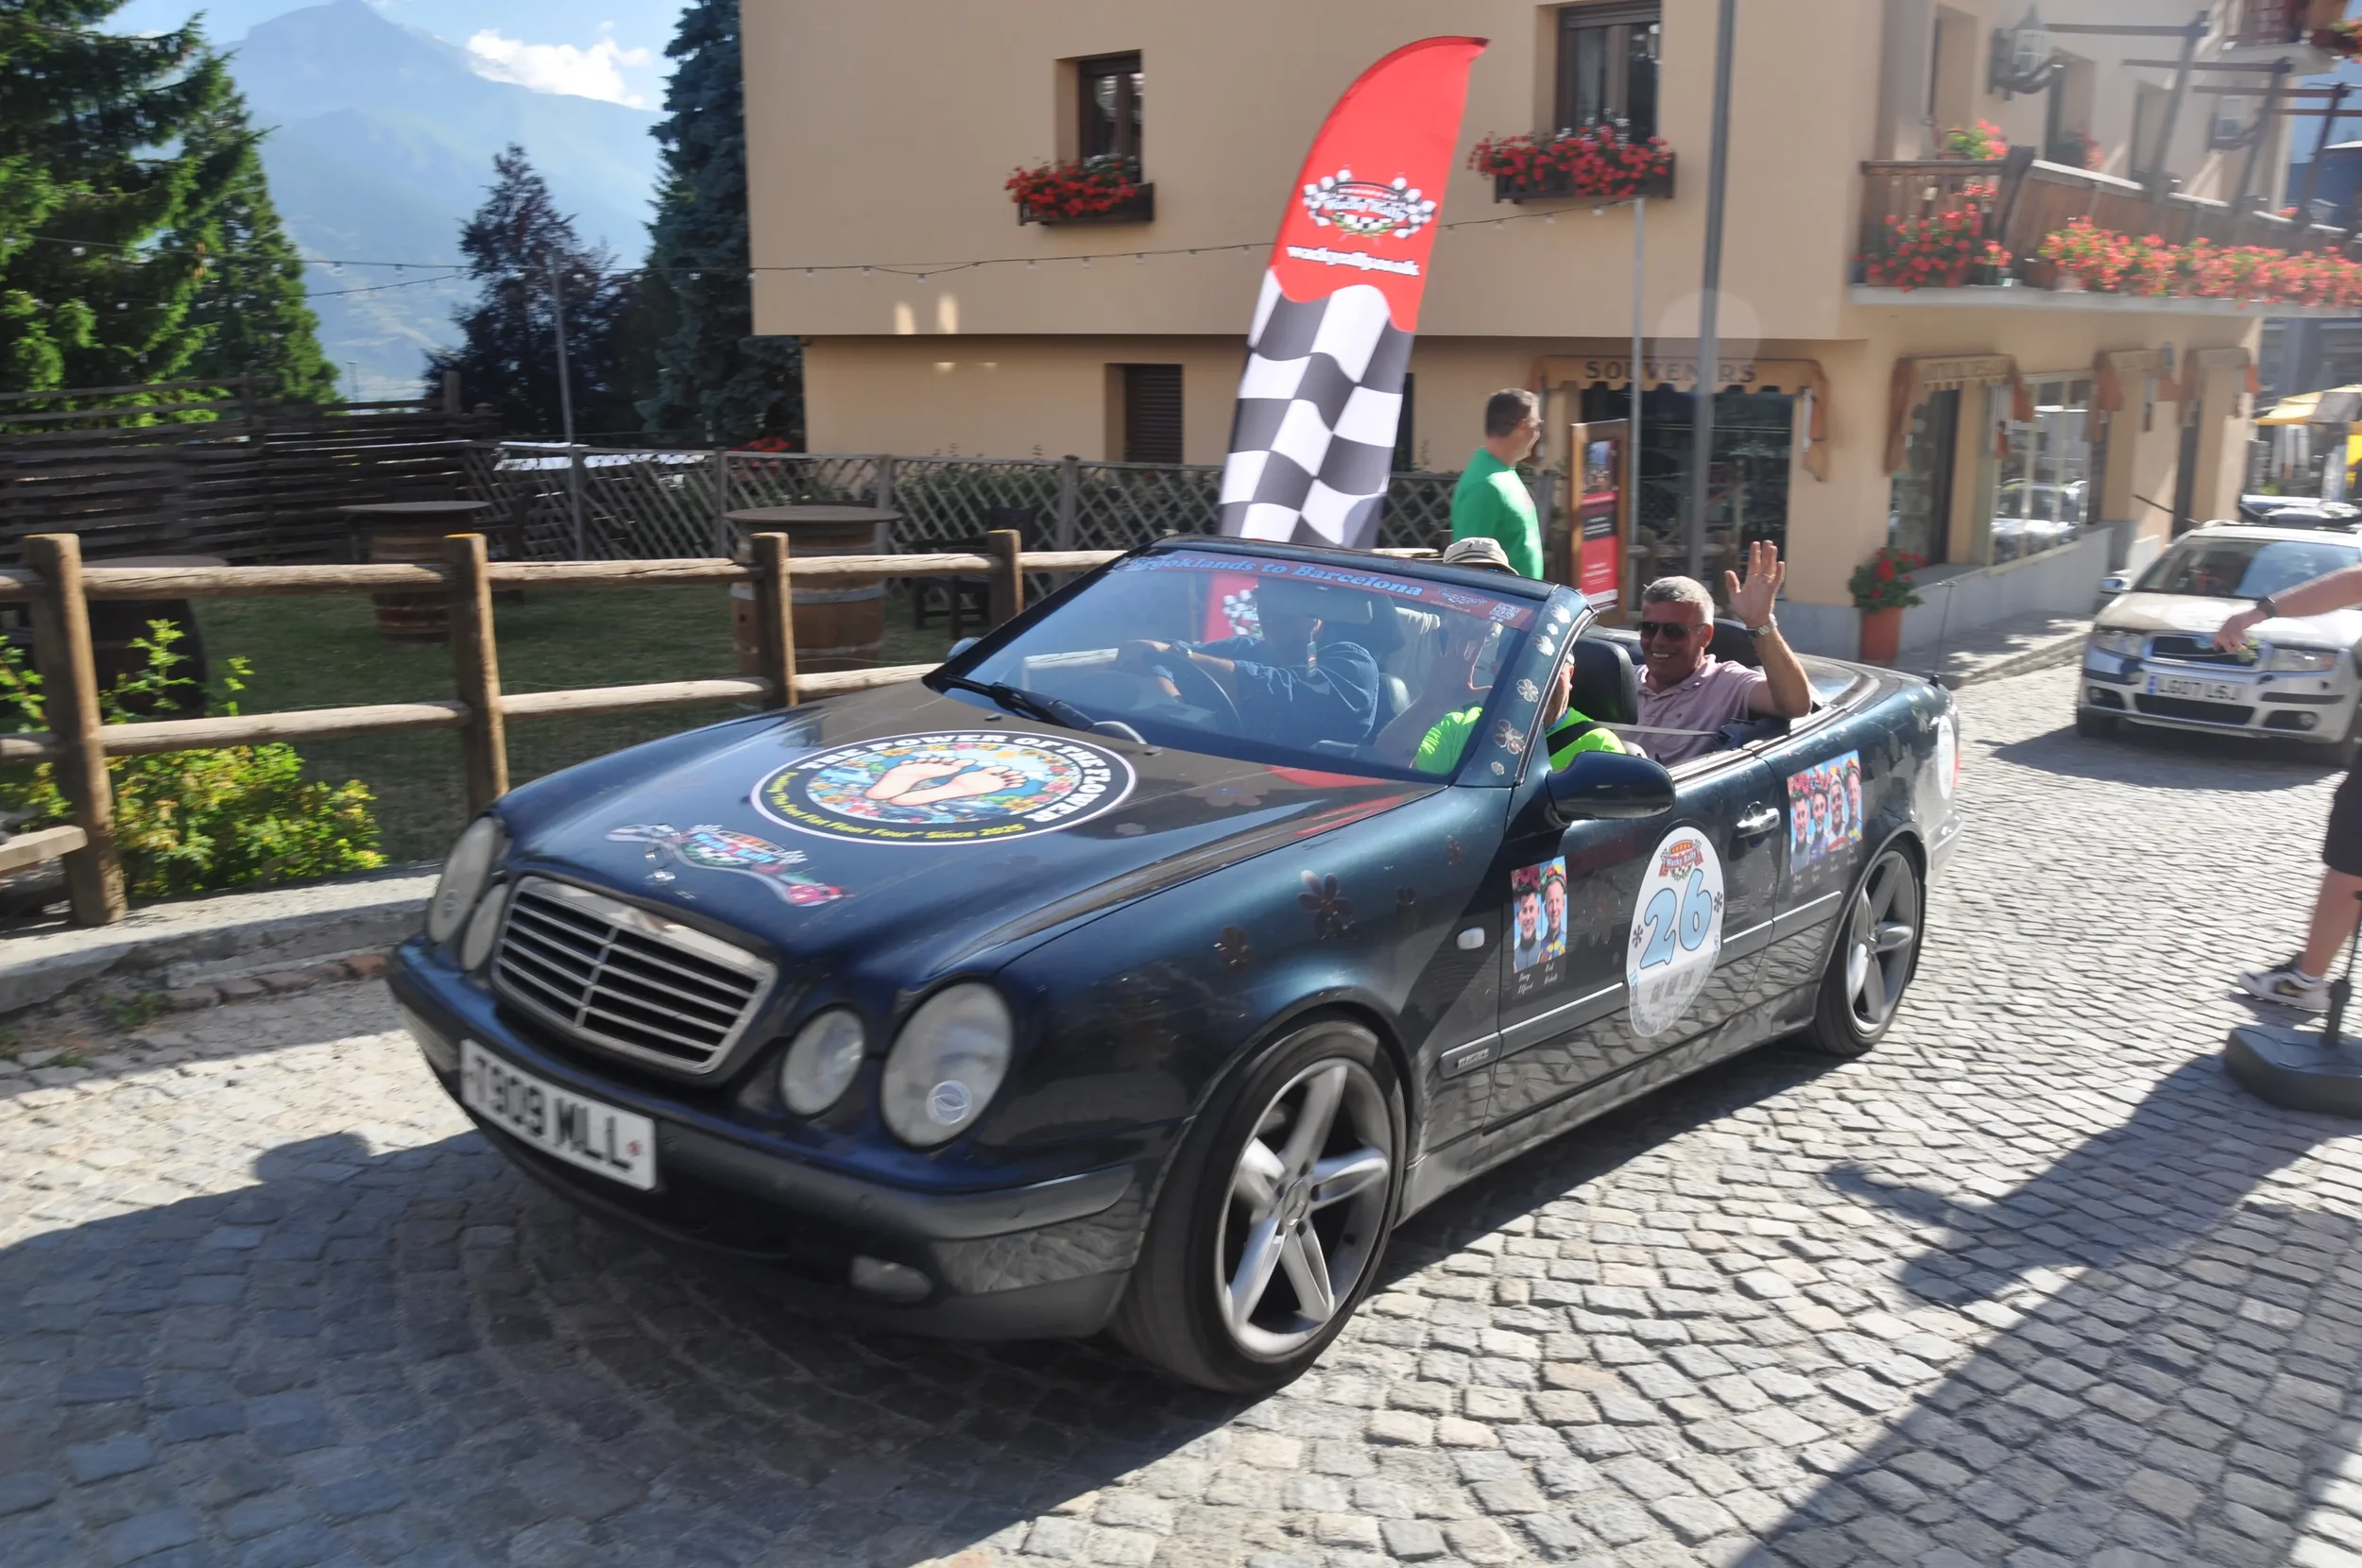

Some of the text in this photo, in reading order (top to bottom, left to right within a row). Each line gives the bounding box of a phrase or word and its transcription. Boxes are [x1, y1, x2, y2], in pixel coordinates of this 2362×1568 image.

[1128, 556, 1257, 571] Brooklands
[1260, 563, 1288, 574] to
[1291, 564, 1424, 597] Barcelona
[796, 734, 1113, 823] THE POWER OF THE FLOWER
[796, 813, 831, 827] Flat
[825, 821, 872, 834] Floor
[924, 829, 978, 840] Since
[977, 823, 1027, 838] 2025
[1665, 847, 1698, 867] Wacky Rally
[1639, 867, 1704, 970] 26
